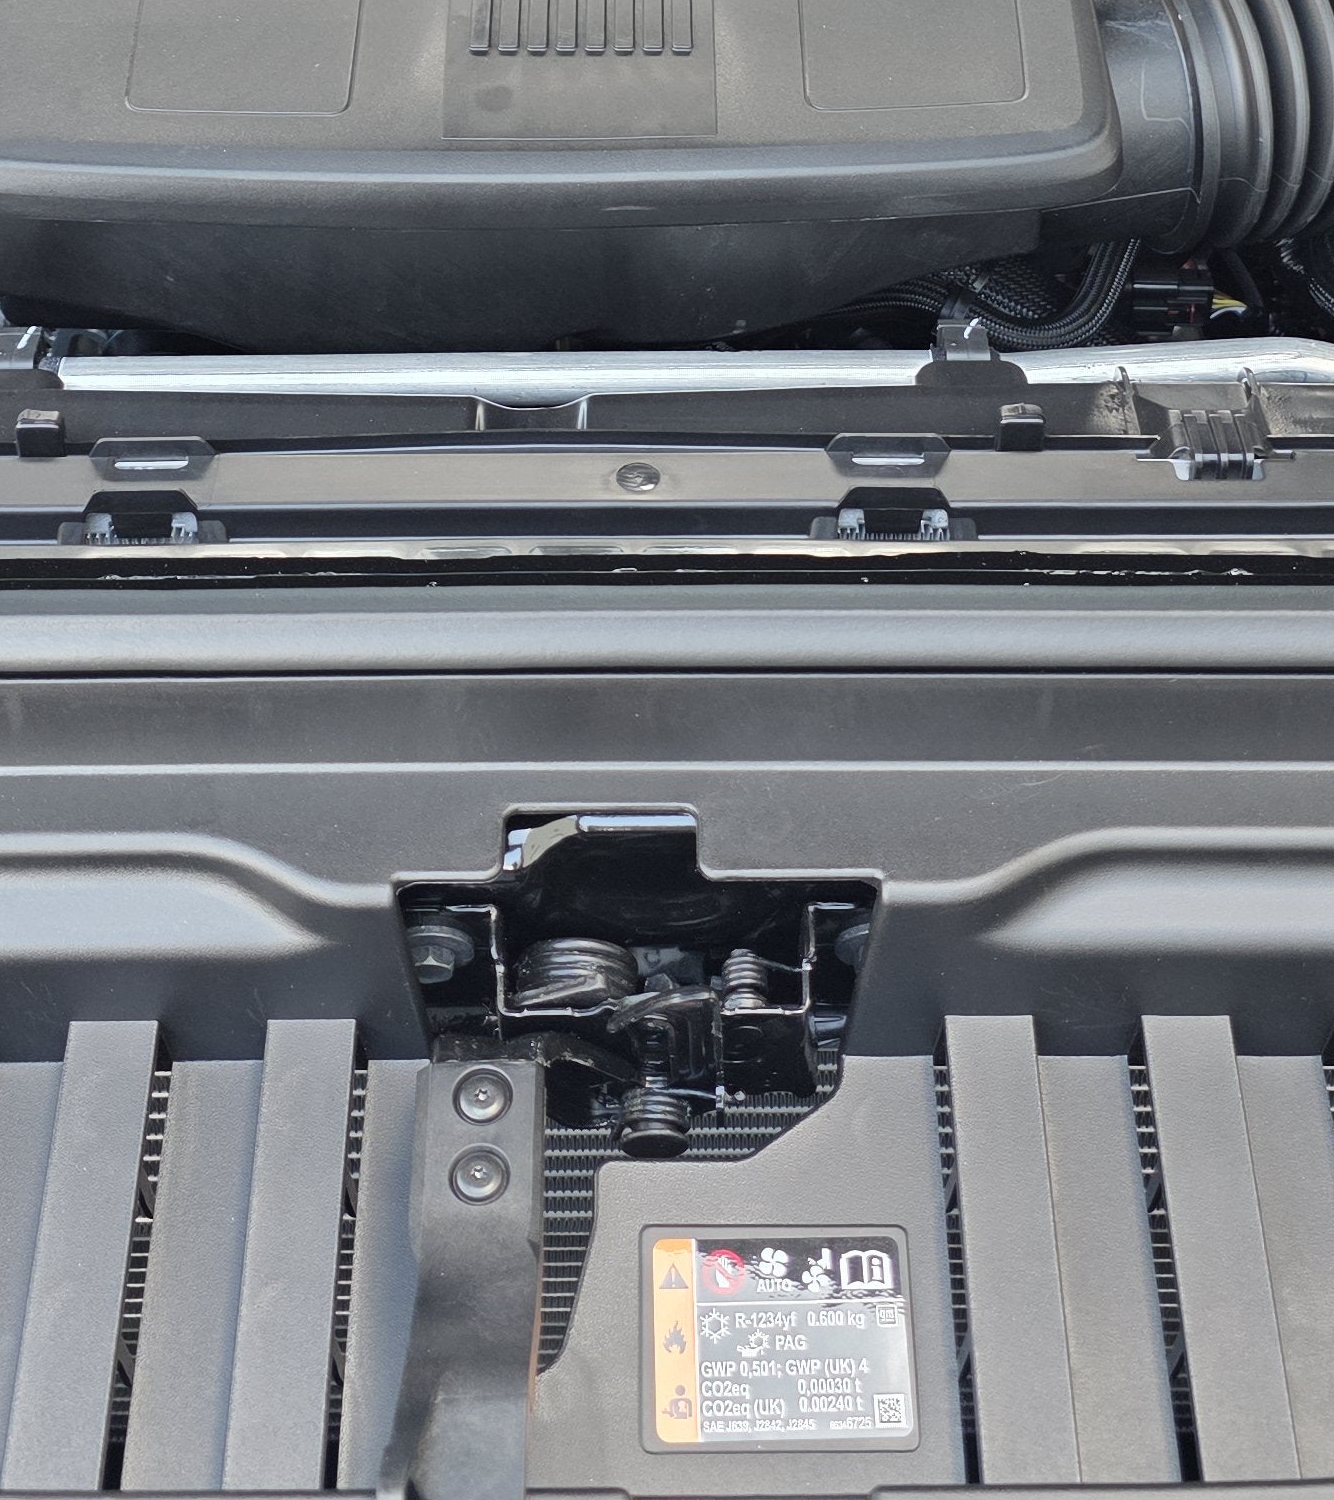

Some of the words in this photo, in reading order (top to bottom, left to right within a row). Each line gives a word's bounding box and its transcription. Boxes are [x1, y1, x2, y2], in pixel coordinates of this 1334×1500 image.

[756, 1278, 792, 1293] AUTO
[735, 1311, 797, 1331] R-1234yf
[807, 1310, 844, 1326] 0.600
[847, 1309, 866, 1329] kg
[775, 1334, 807, 1350] PAG
[701, 1361, 736, 1378] GWP
[785, 1359, 821, 1376] GWP
[824, 1358, 855, 1378] (UK)
[858, 1357, 870, 1374] 4
[701, 1380, 751, 1400] CO2eq
[854, 1377, 864, 1394] t
[702, 1399, 752, 1419] CO2eq
[753, 1398, 786, 1419] (UK)
[856, 1395, 866, 1412] t
[703, 1420, 725, 1433] SAE
